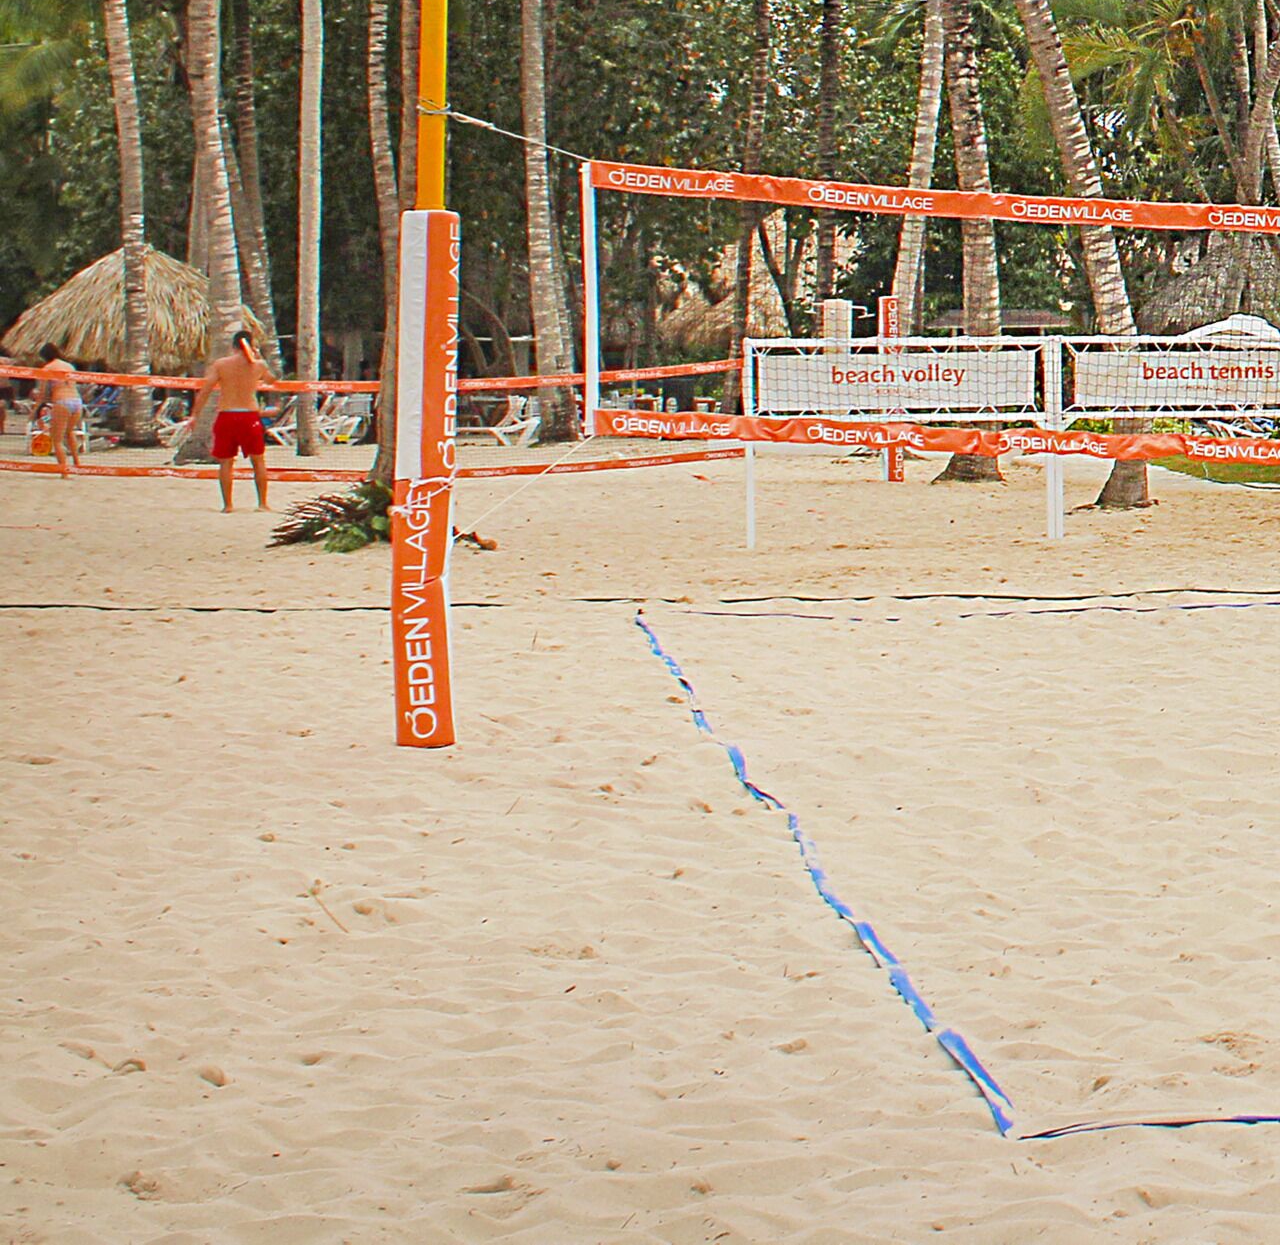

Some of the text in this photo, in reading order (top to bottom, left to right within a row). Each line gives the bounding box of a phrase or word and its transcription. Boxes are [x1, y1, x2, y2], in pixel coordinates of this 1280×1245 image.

[626, 173, 734, 192] EDEN VILLAGE
[825, 189, 934, 210] EDEN VILLAGE
[1027, 204, 1133, 221] EDEN VILLAGE
[1223, 212, 1266, 226] EDEN
[832, 363, 965, 386] beach volley
[1143, 360, 1274, 380] beach tennis
[628, 418, 670, 434] EDEN
[824, 429, 870, 443] EDEN
[1013, 437, 1051, 452] EDEN
[1196, 443, 1240, 458] EDEN
[401, 490, 435, 706] EDEN VILLAGE
